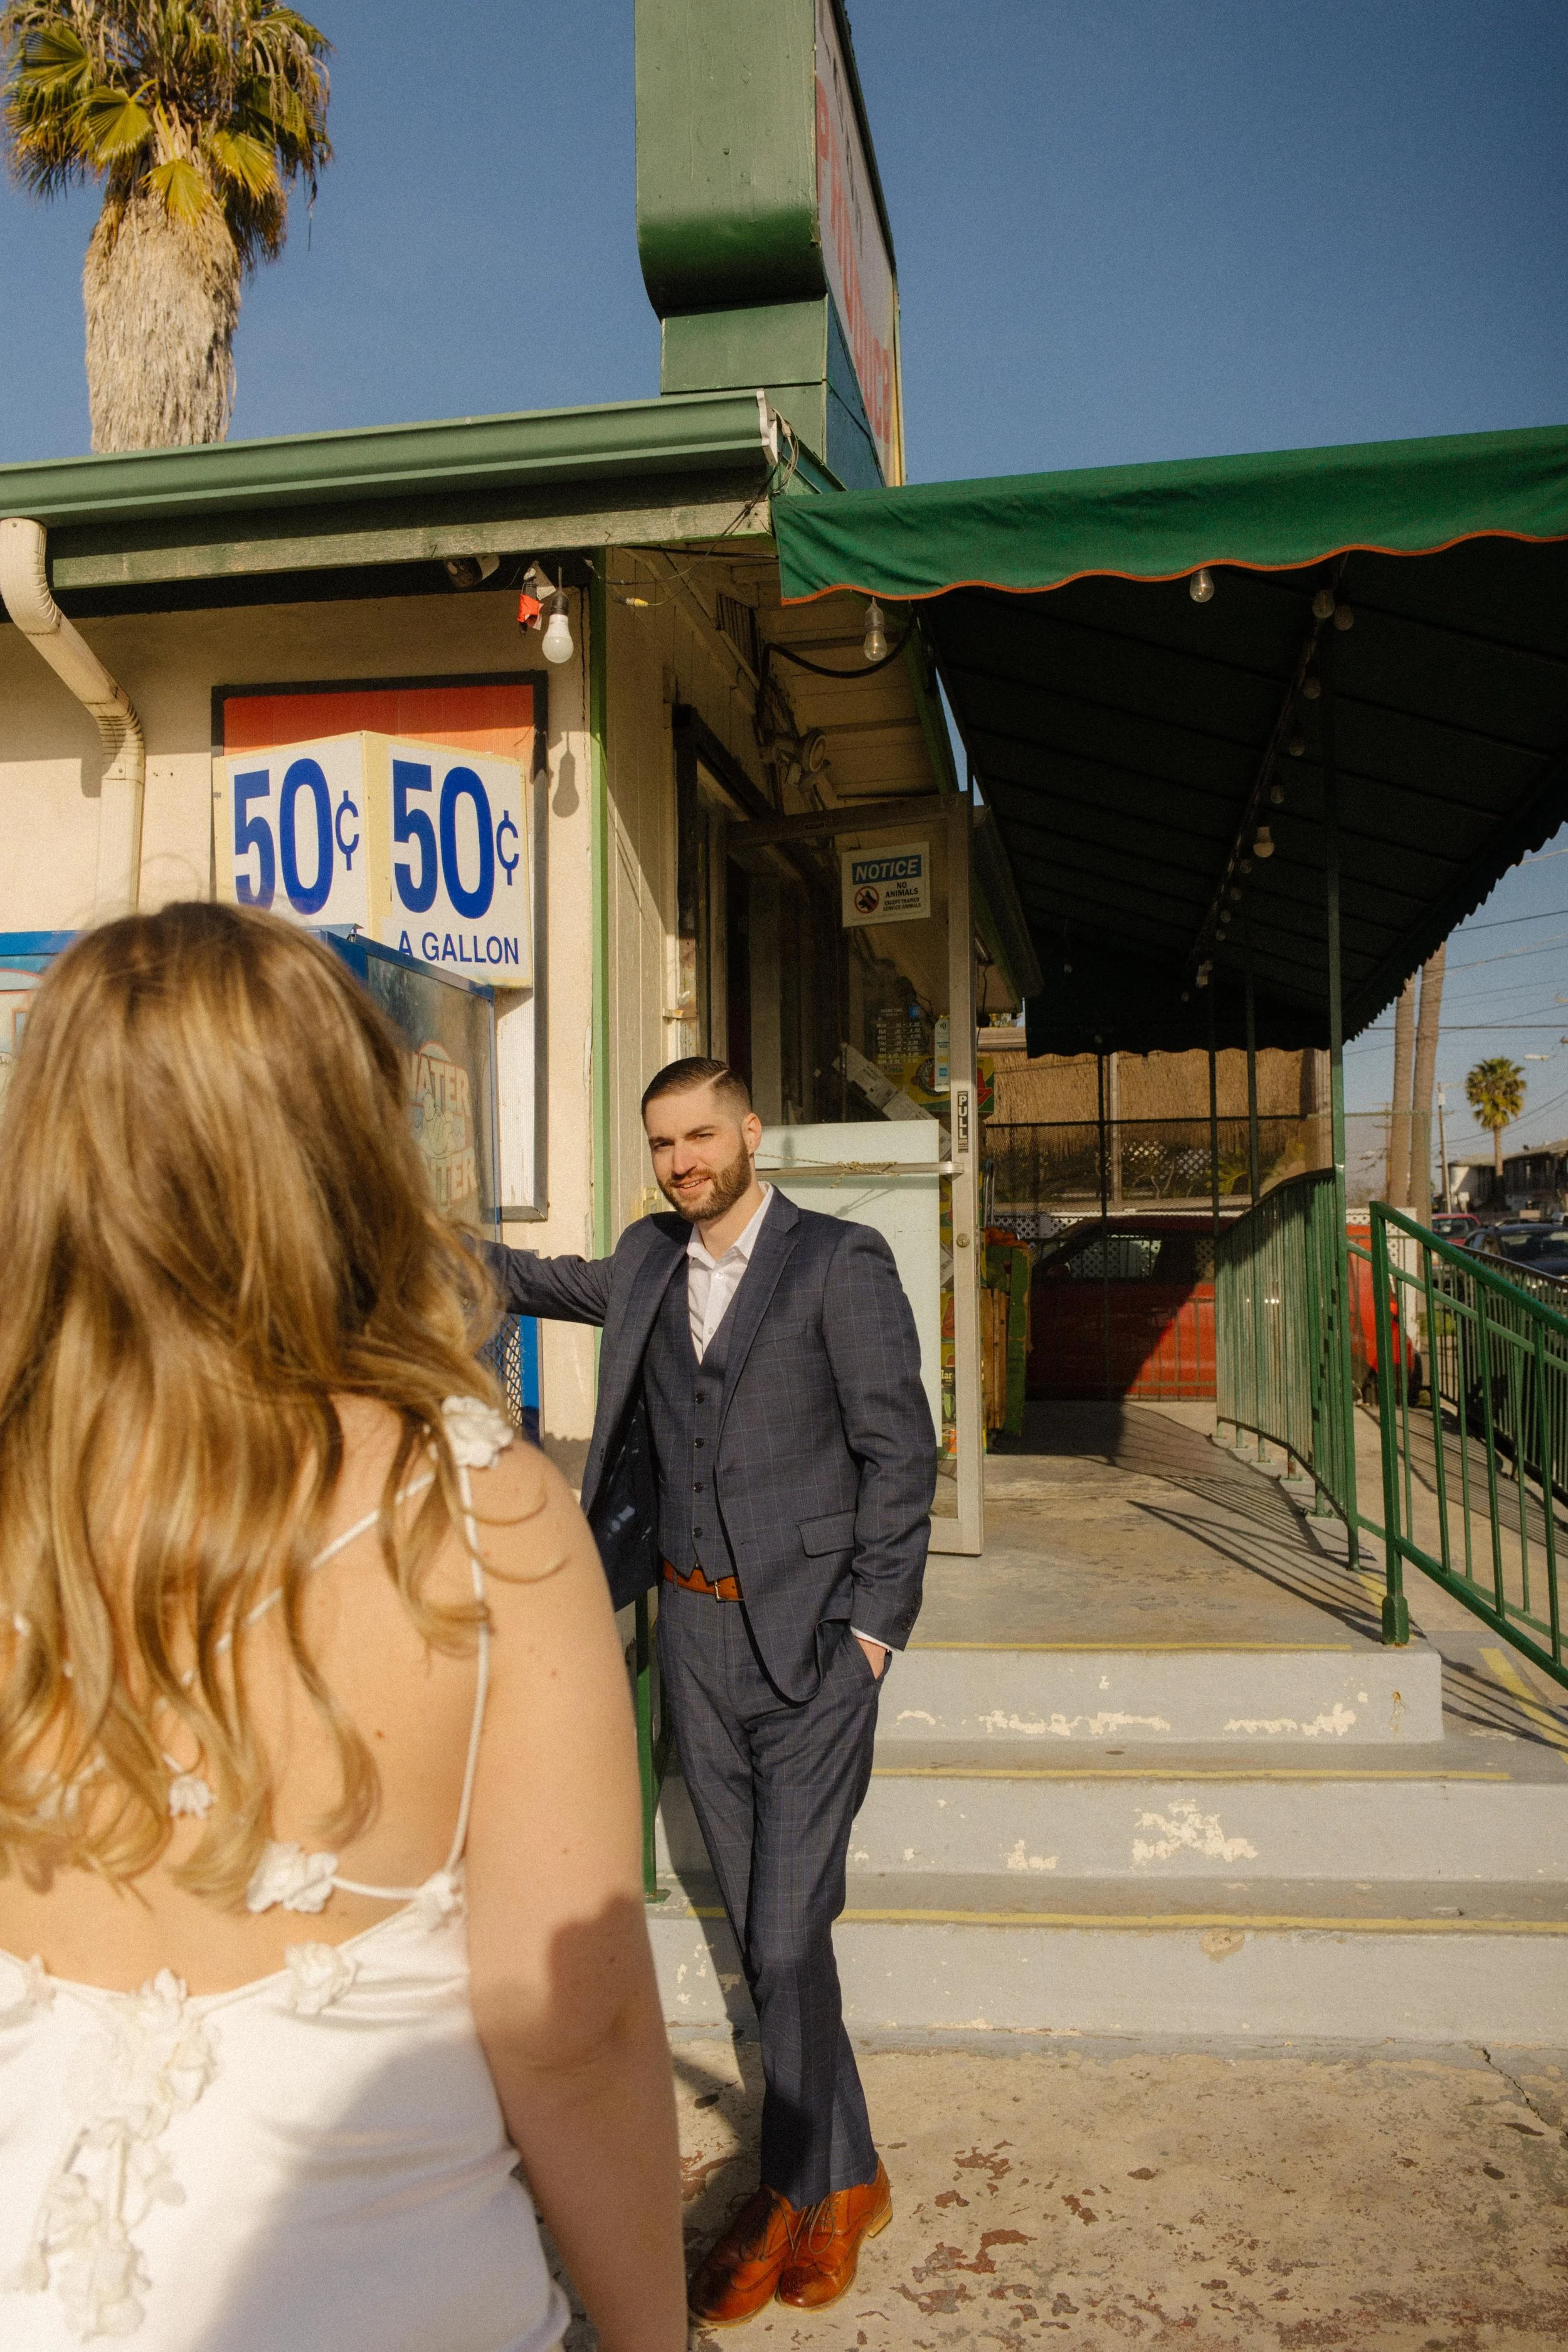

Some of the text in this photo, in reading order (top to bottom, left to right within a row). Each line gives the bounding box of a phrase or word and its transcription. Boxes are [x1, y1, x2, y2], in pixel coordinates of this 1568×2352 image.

[392, 759, 520, 919] 50¢
[856, 858, 919, 881] NOTICE
[885, 887, 919, 899] ANIMALS
[896, 881, 907, 889] NO
[398, 930, 519, 965] A GALLON
[958, 1095, 968, 1139] PULL
